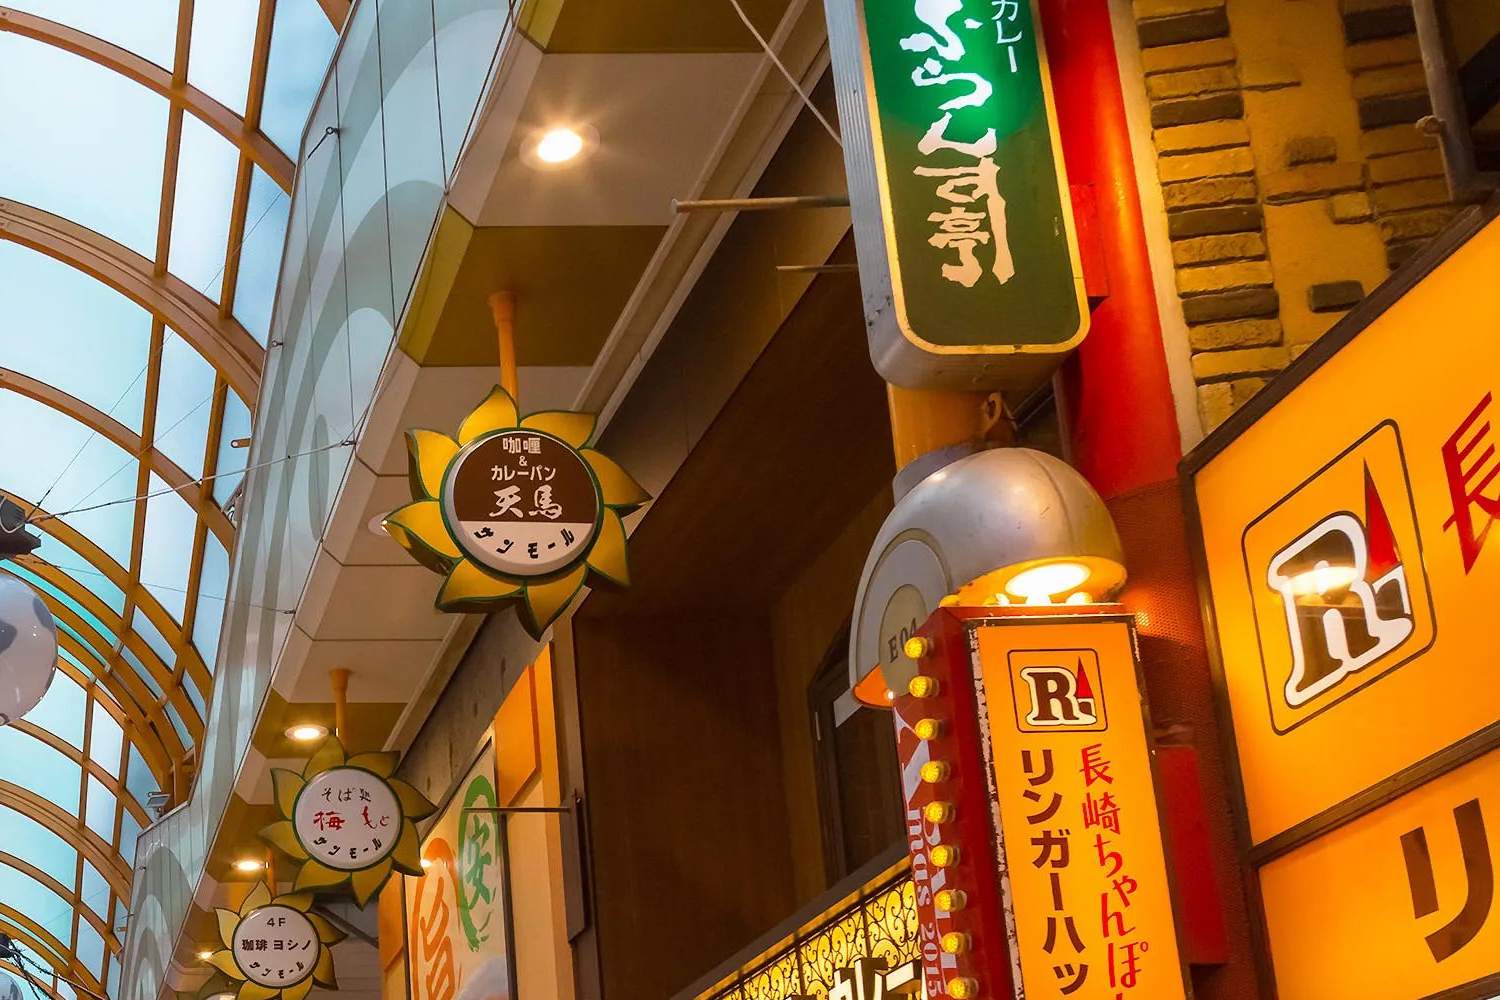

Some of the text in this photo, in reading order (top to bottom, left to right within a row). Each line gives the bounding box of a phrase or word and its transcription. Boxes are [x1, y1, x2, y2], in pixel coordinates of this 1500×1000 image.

[518, 455, 528, 467] &
[491, 465, 556, 482] カレーパン
[489, 484, 563, 520] 天馬
[474, 526, 575, 559] サンモール
[322, 787, 373, 804] そば処
[313, 805, 390, 832] 梅もと
[312, 837, 383, 859] サンモール
[266, 917, 287, 928] 4F
[241, 938, 311, 951] 珈琲 ヨシノ
[921, 922, 943, 998] 2015
[249, 962, 305, 979] サンモール
